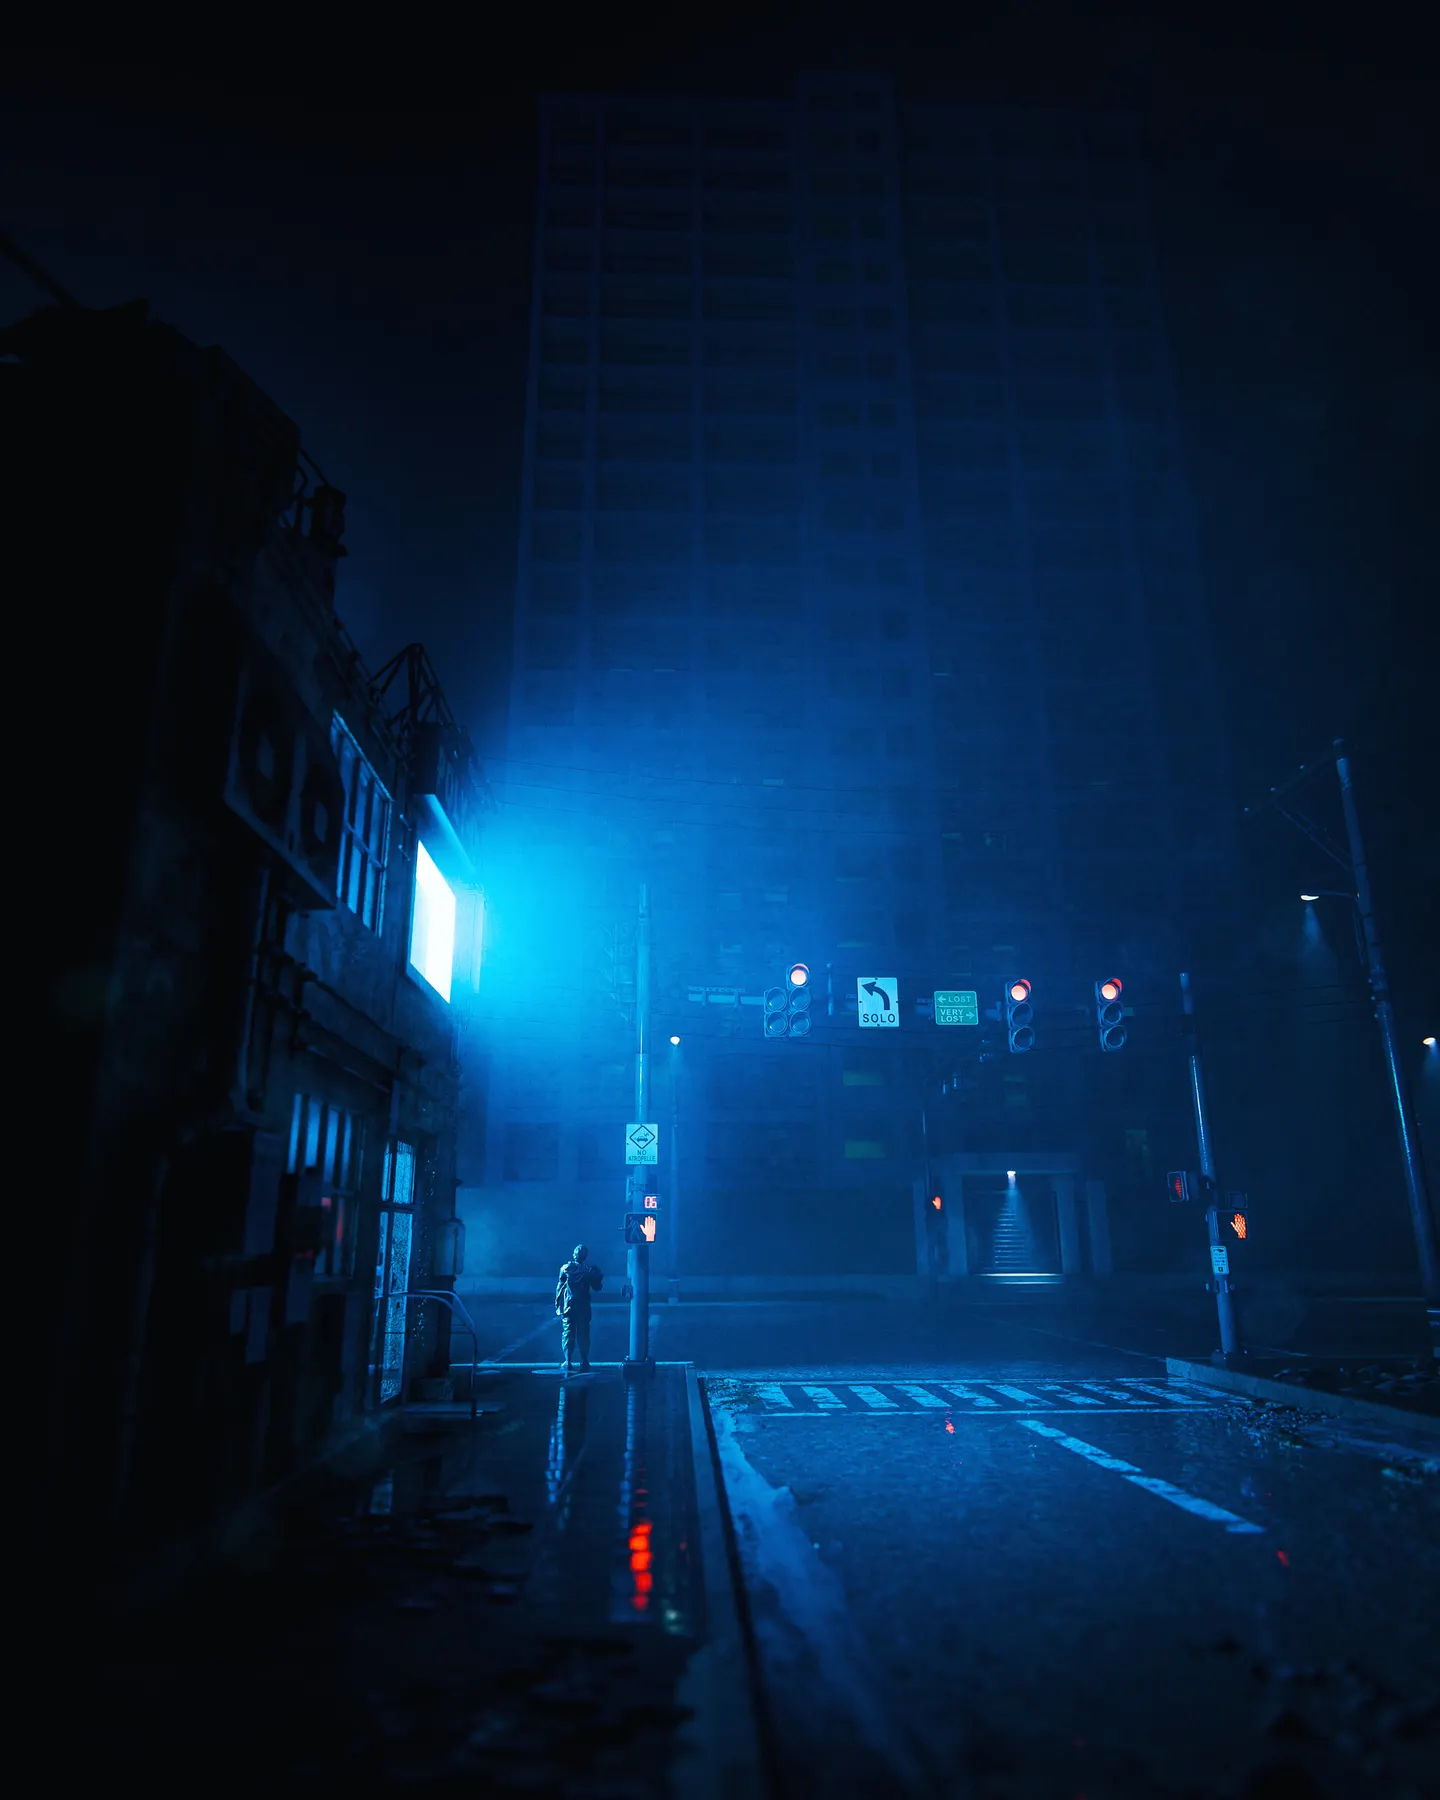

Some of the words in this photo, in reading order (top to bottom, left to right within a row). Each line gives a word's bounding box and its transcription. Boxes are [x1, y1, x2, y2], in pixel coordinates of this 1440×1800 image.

[948, 995, 972, 1003] LOST
[862, 1013, 896, 1023] SOLO
[940, 1015, 964, 1023] LOST
